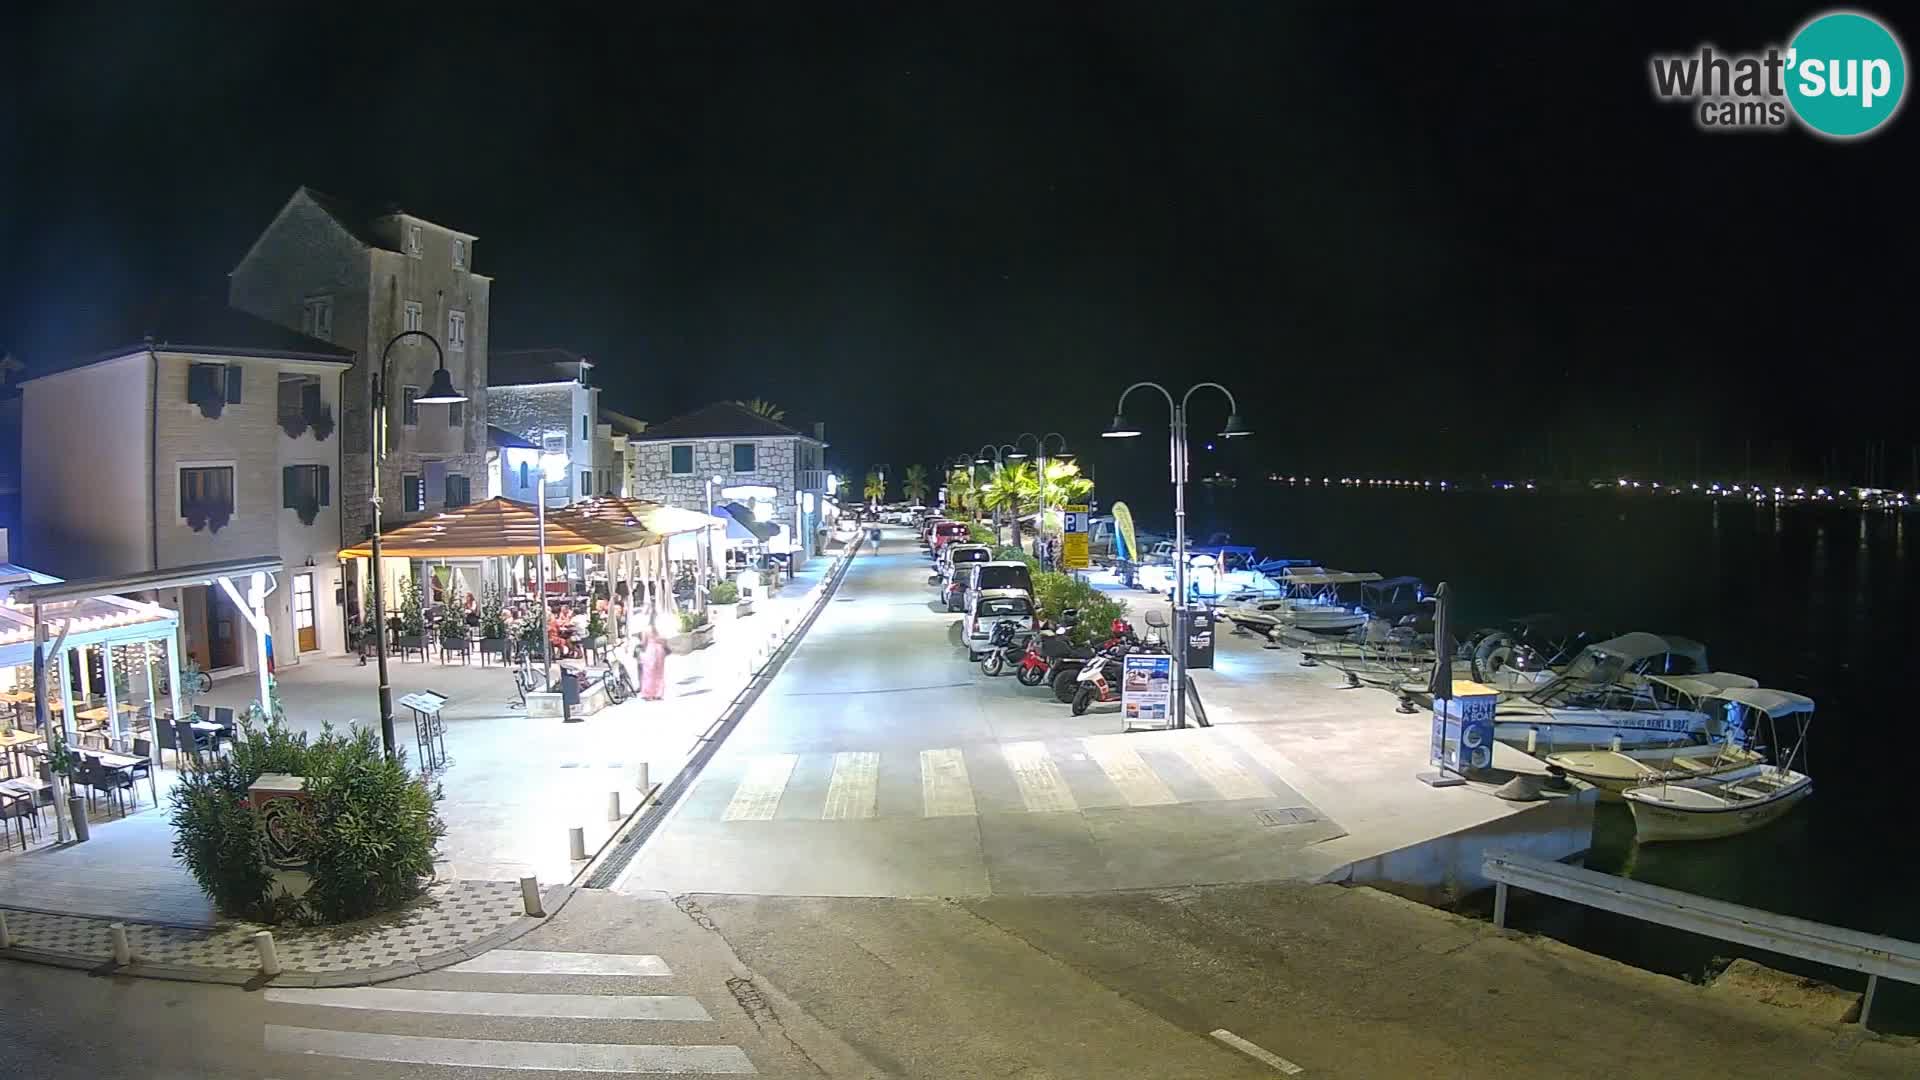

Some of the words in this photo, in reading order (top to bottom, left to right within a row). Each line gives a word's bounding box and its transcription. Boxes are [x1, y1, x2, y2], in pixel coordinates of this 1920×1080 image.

[1065, 515, 1075, 530] P
[1463, 702, 1494, 713] RENT
[1463, 713, 1470, 721] A
[1471, 712, 1494, 721] BOAT
[1646, 719, 1664, 729] RENT
[1665, 719, 1671, 729] A
[1673, 719, 1689, 731] BOAT
